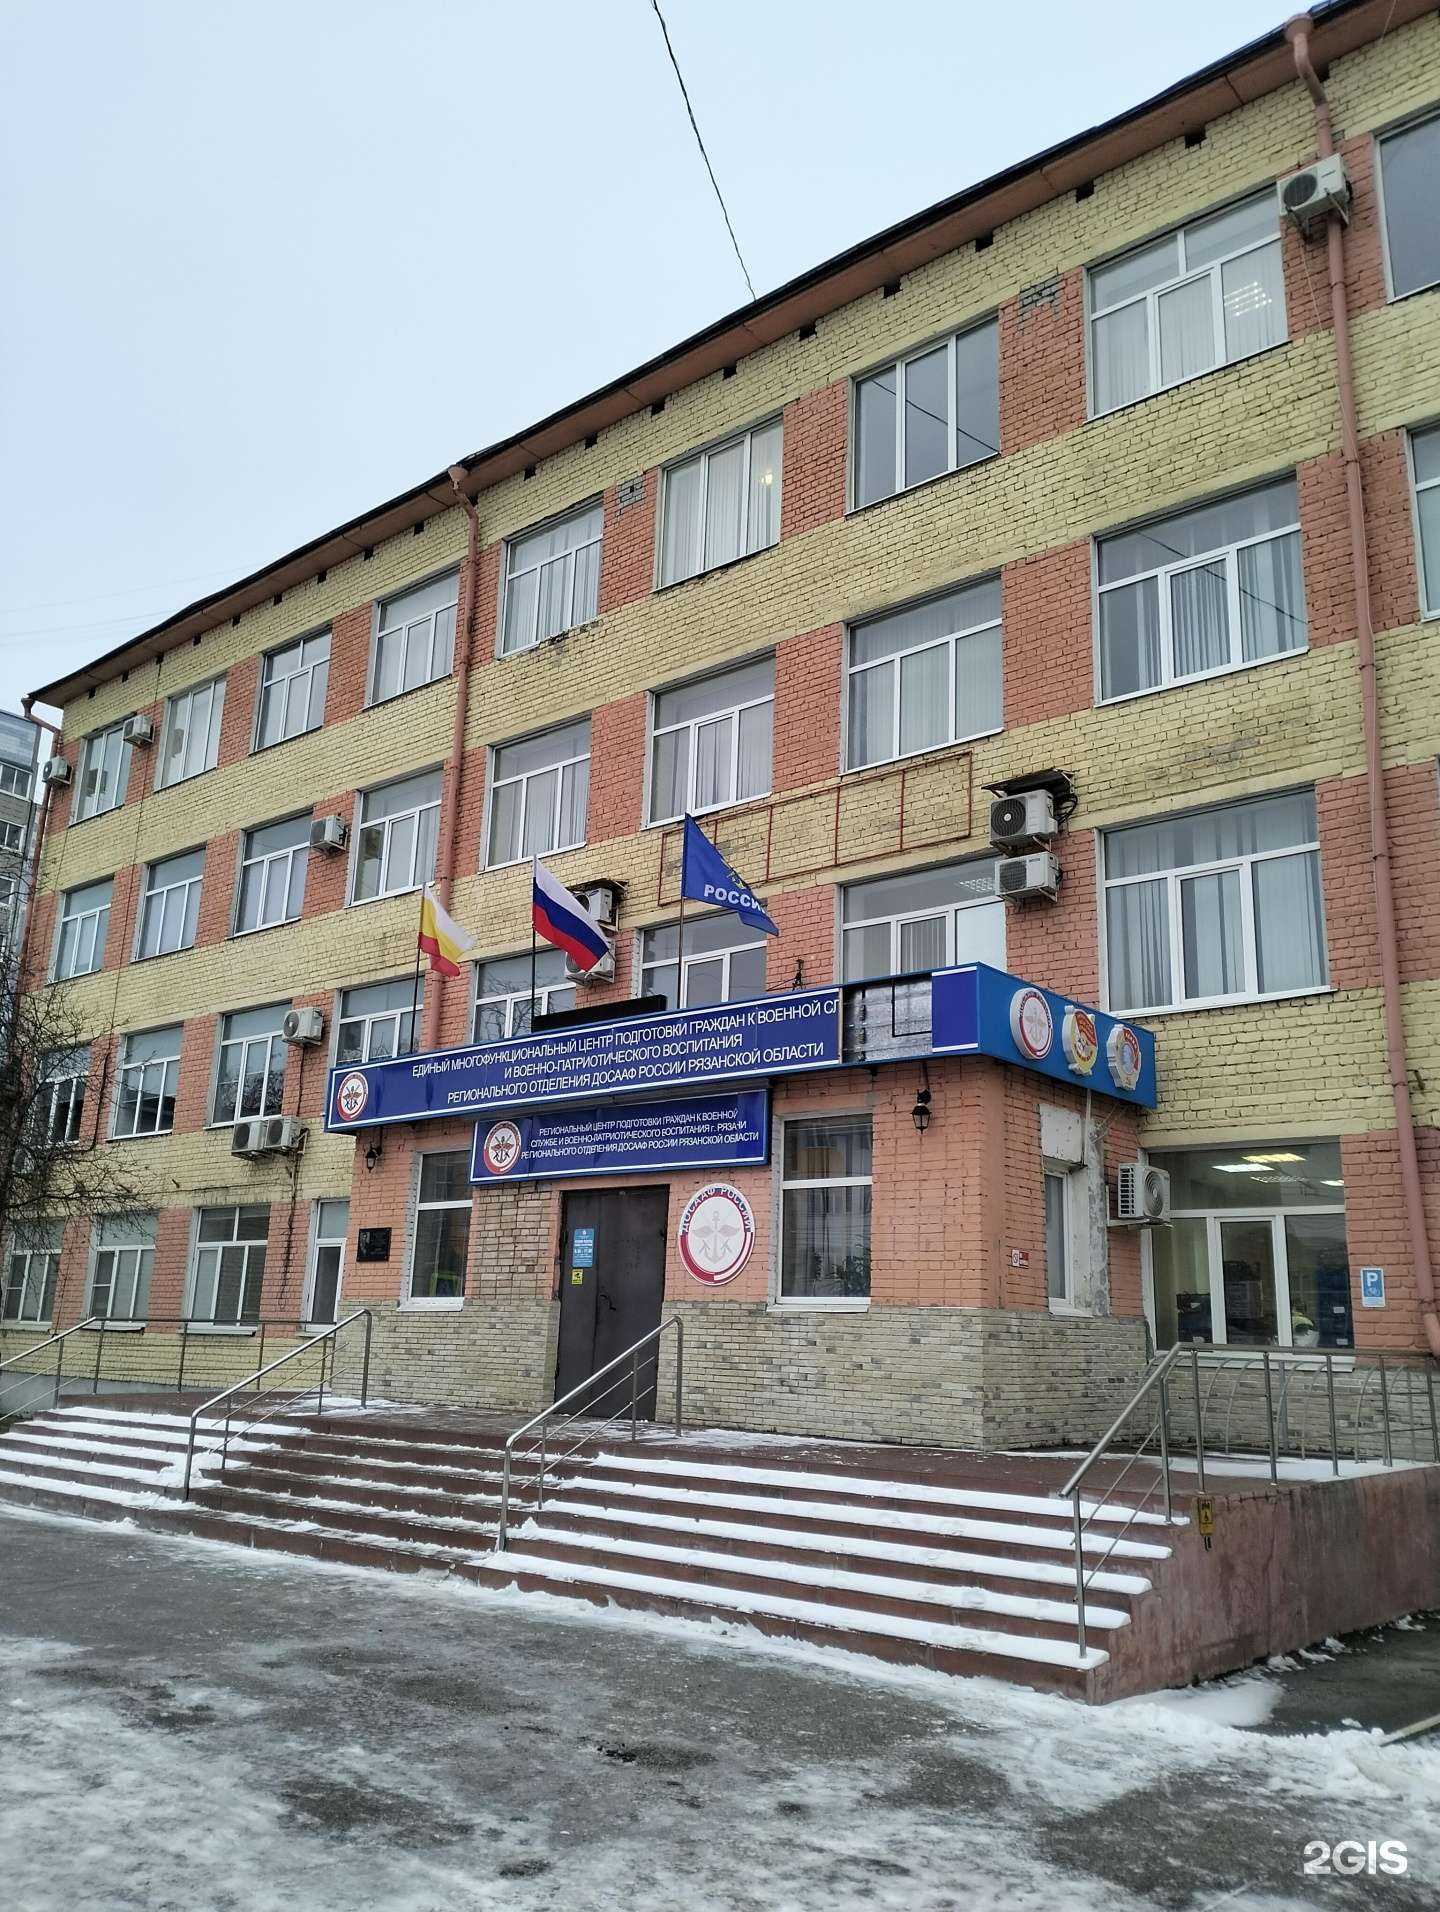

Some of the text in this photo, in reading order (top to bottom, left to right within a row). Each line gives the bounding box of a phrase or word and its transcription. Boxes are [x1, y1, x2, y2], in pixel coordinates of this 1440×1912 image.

[704, 884, 766, 913] РОССИ
[412, 1058, 450, 1077] ЕДИНЫЙ
[451, 1038, 577, 1069] МНОГОФУНКЦИОНАЛЬНЫЙ
[579, 1033, 613, 1053] ЦЕНТР
[615, 1021, 687, 1047] ПОДГОТОВКИ
[689, 1013, 745, 1034] ГРАЖДАН
[748, 1012, 757, 1025] К
[757, 1000, 821, 1024] ВОЕННОЙ
[504, 1034, 742, 1079] И ВОЕННО-ПАТРИОТИЧЕСКОГО ВОСПИТАНИЯ
[447, 1042, 823, 1104] РЕГИОНАЛЬНОГО ОТДЕЛЕНИЯ ДОСААФ РОССИИ РЯЗАНСКОЙ ОБЛАСТИ
[530, 1138, 558, 1148] СЛУЖБЕ
[558, 1138, 564, 1146] И
[661, 1124, 709, 1136] ВОСПИТАНИЯ
[539, 1108, 738, 1136] РЕГИОНАЛЬНЫЙ ЦЕНТР ПОДГОТОВКИ ГРАЖДАН К ВОЕННОЙ
[521, 1149, 576, 1159] РЕГИОНАЛЬНОГО
[617, 1141, 648, 1152] ДОСААФ
[648, 1138, 679, 1149] РОССИИ
[679, 1133, 723, 1146] РЯЗАНСКОЙ
[724, 1131, 759, 1144] ОБЛАСТИ
[1366, 1272, 1379, 1287] P
